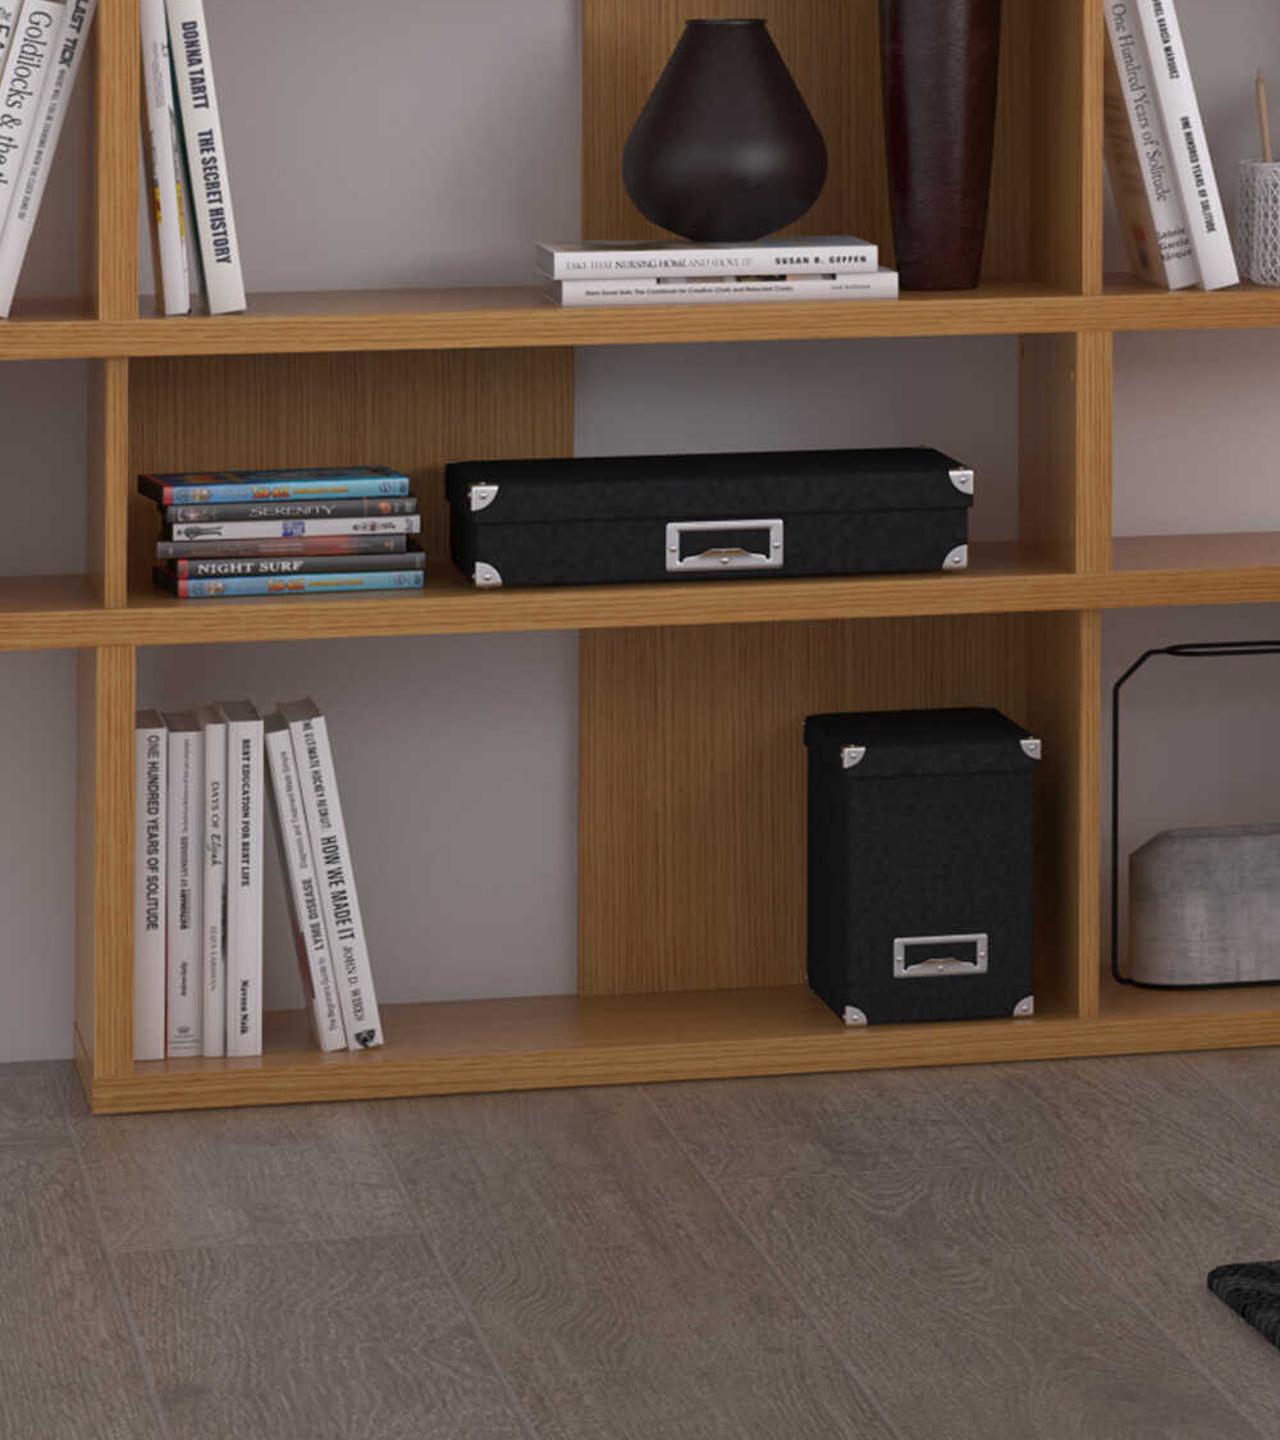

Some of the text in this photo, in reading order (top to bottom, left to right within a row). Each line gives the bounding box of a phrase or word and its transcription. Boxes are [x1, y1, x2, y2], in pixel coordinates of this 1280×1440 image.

[1110, 1, 1131, 33] One
[3, 8, 54, 112] Goldilocks
[57, 35, 78, 69] TICK
[180, 20, 209, 111] DONNA TARTT
[1118, 33, 1146, 92] Hundred
[1131, 92, 1154, 130] Years
[1141, 129, 1159, 148] of
[196, 128, 231, 265] THE SECRET HISTORY
[1145, 147, 1172, 203] Solitude
[249, 505, 337, 518] SERENITY
[196, 560, 304, 575] NIGHT SURF
[146, 735, 160, 931] ONE HUNDRED YEARS OF SOLITUDE
[240, 739, 251, 887] BEST EDUCATION FOR BEST LIFE
[300, 877, 324, 951] LYME DISEASE
[319, 834, 355, 941] HOW WE MADE IT
